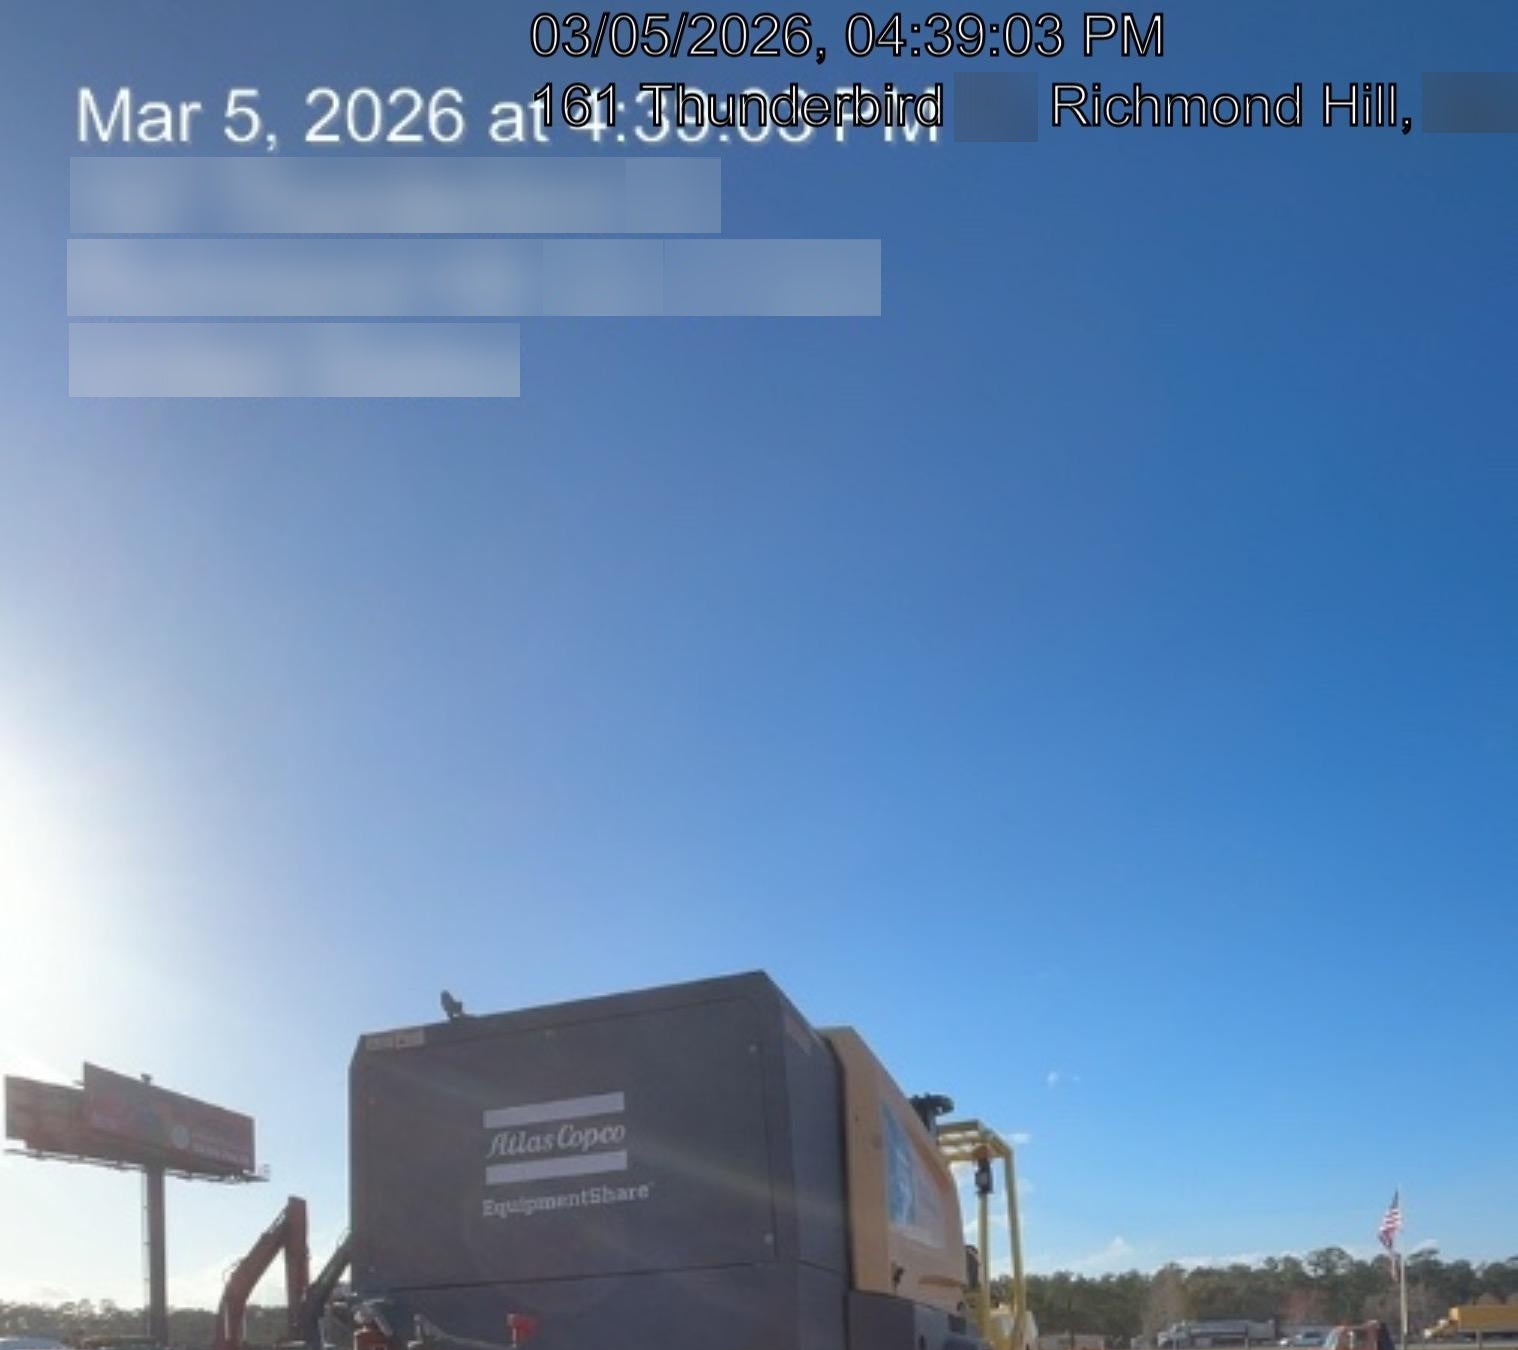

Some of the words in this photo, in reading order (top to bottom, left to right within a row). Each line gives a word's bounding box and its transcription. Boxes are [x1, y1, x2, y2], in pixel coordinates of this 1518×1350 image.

[486, 1129, 554, 1159] Atlas
[557, 1123, 626, 1151] Copco
[482, 1182, 650, 1219] EquipmentShare
